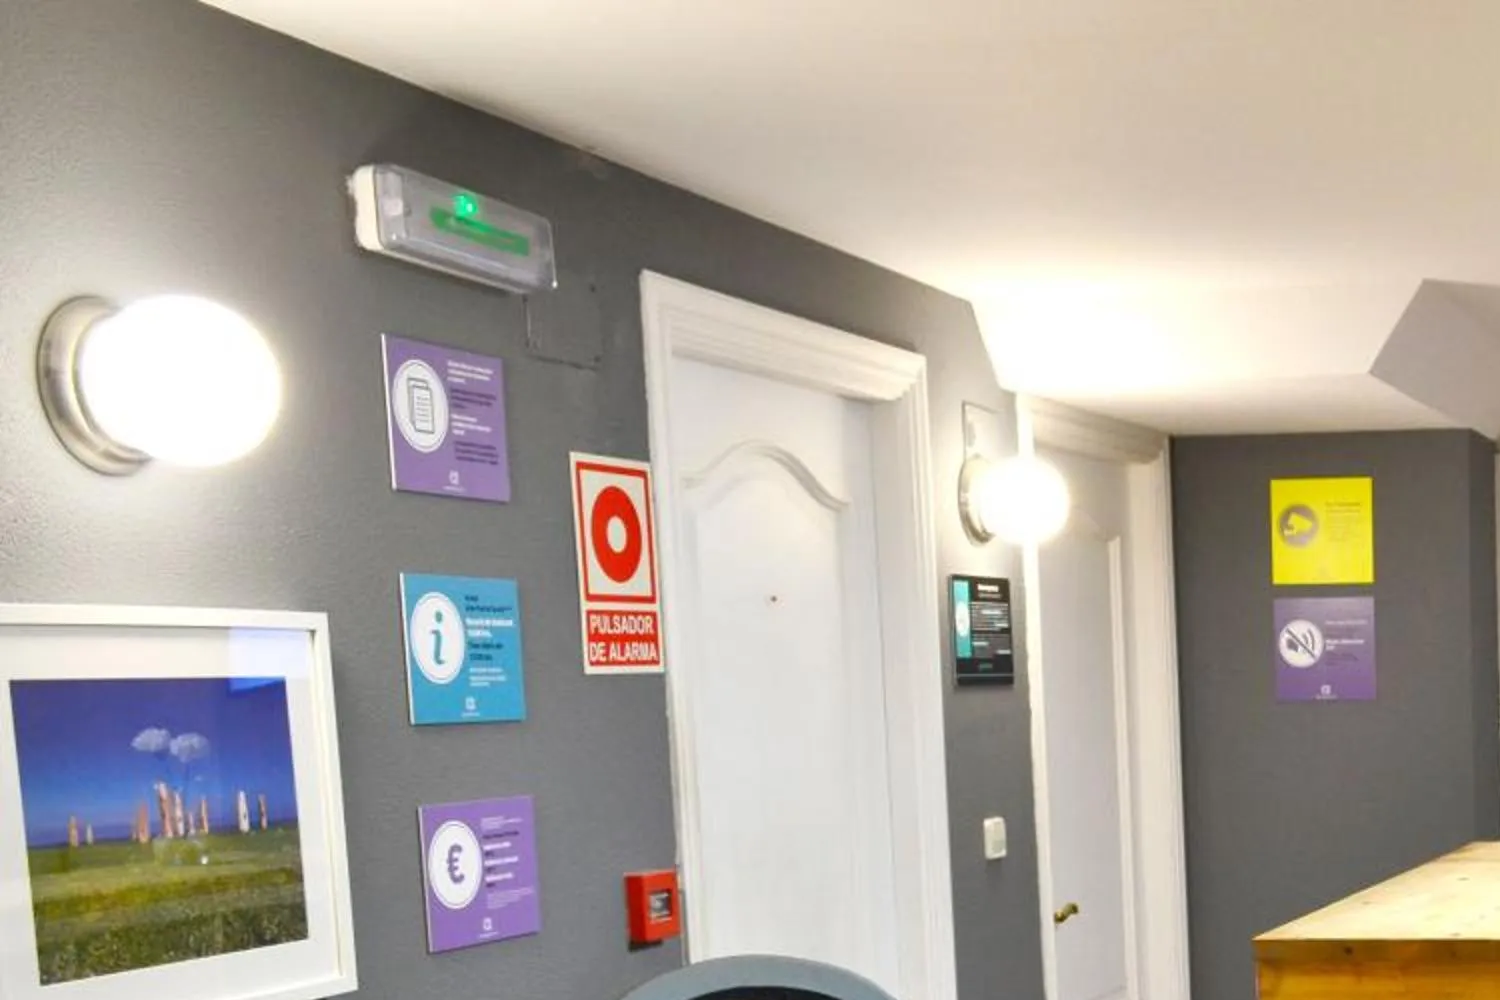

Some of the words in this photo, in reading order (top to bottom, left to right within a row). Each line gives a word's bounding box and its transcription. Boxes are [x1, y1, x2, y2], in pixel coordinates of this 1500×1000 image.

[589, 614, 653, 634] PULSADOR
[589, 641, 607, 662] DE
[609, 641, 657, 662] ALARMA
